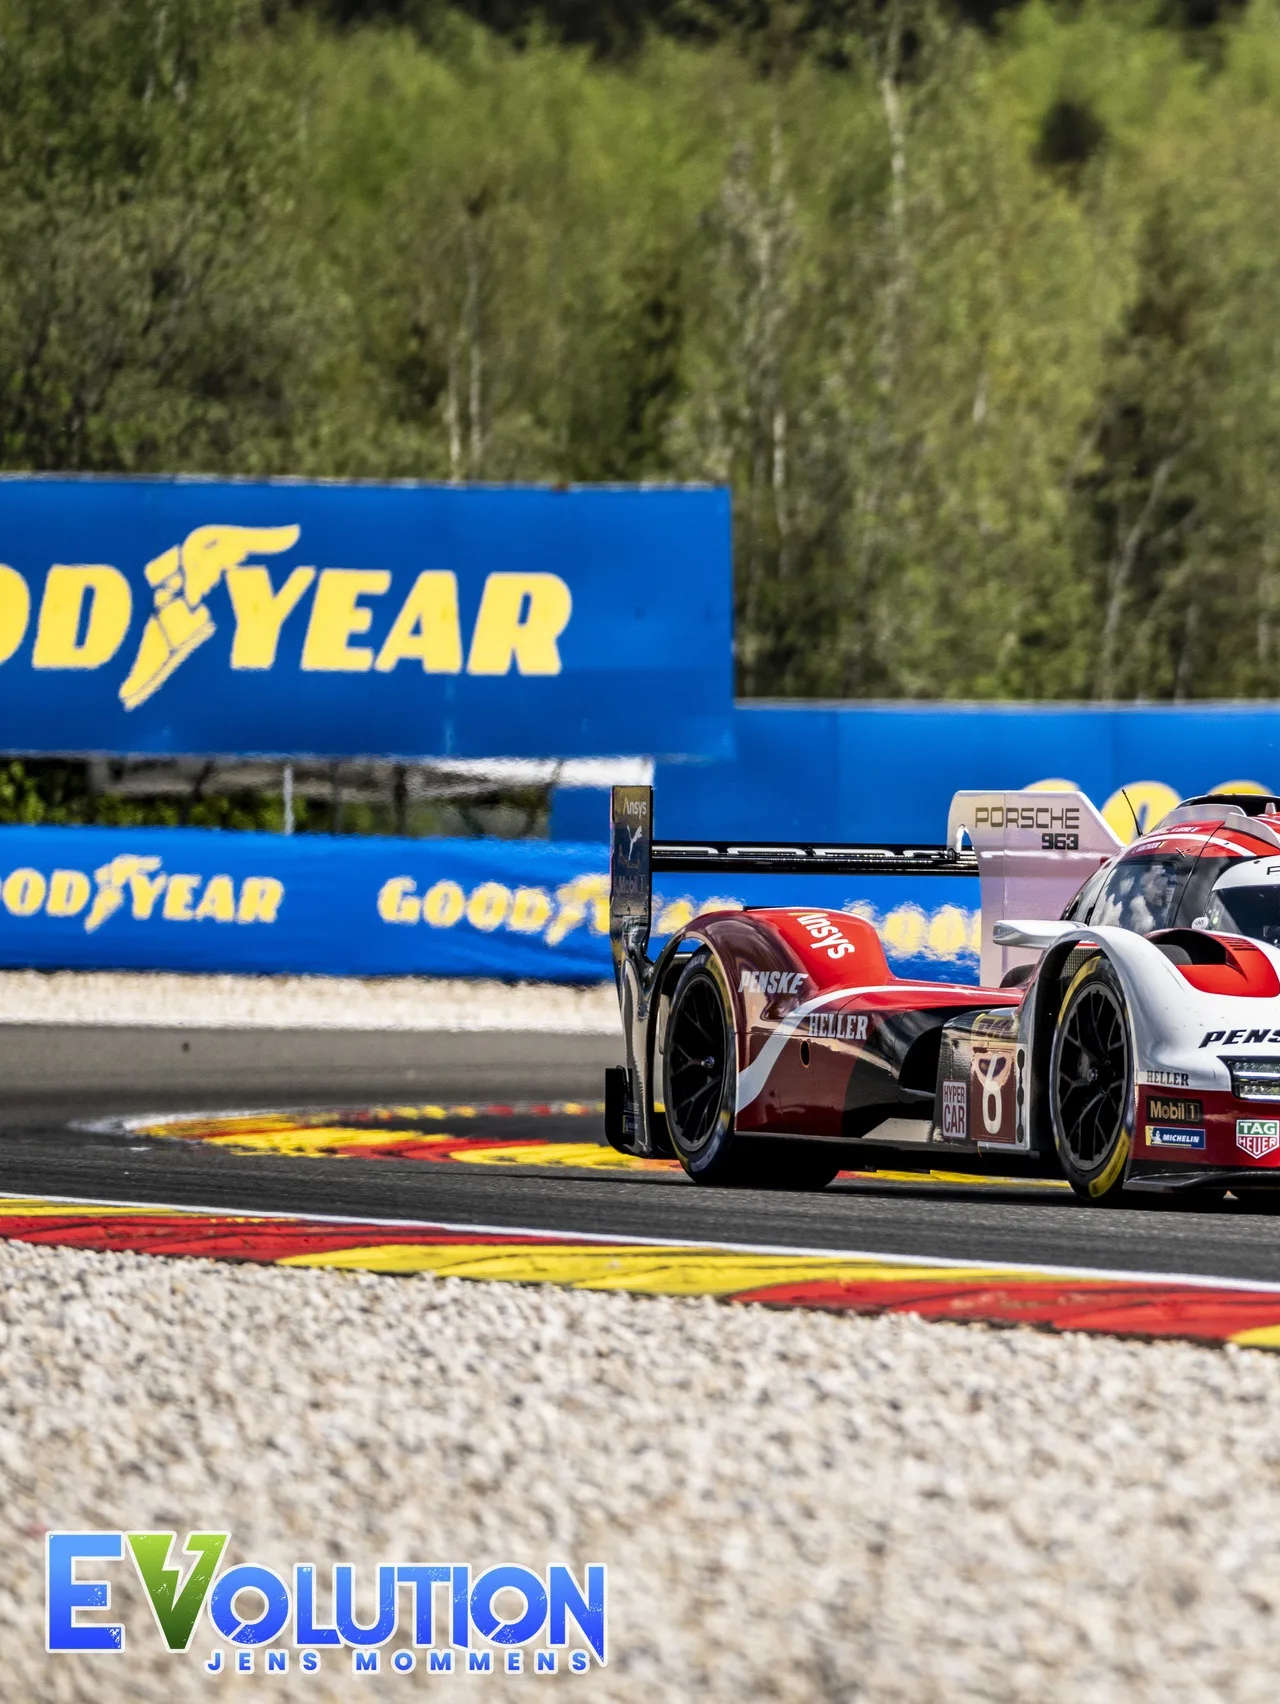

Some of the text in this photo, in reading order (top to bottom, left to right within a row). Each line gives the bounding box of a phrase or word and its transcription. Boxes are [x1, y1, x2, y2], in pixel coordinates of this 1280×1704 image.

[623, 797, 647, 819] Ansys
[975, 807, 1080, 829] PORSCHE
[1041, 833, 1079, 850] 963
[0, 866, 285, 924] ODYEAR
[787, 911, 855, 959] Ansys
[738, 970, 808, 994] PENSKE
[807, 1012, 869, 1040] HELLER
[1146, 1070, 1190, 1087] HELLER
[943, 1084, 966, 1104] HYPER
[982, 1052, 1002, 1134] 6
[943, 1104, 966, 1135] CAR
[1150, 1100, 1185, 1120] Mobil
[1162, 1133, 1200, 1144] MICHELIN
[1239, 1122, 1276, 1135] TAG
[1238, 1136, 1278, 1155] HEUER
